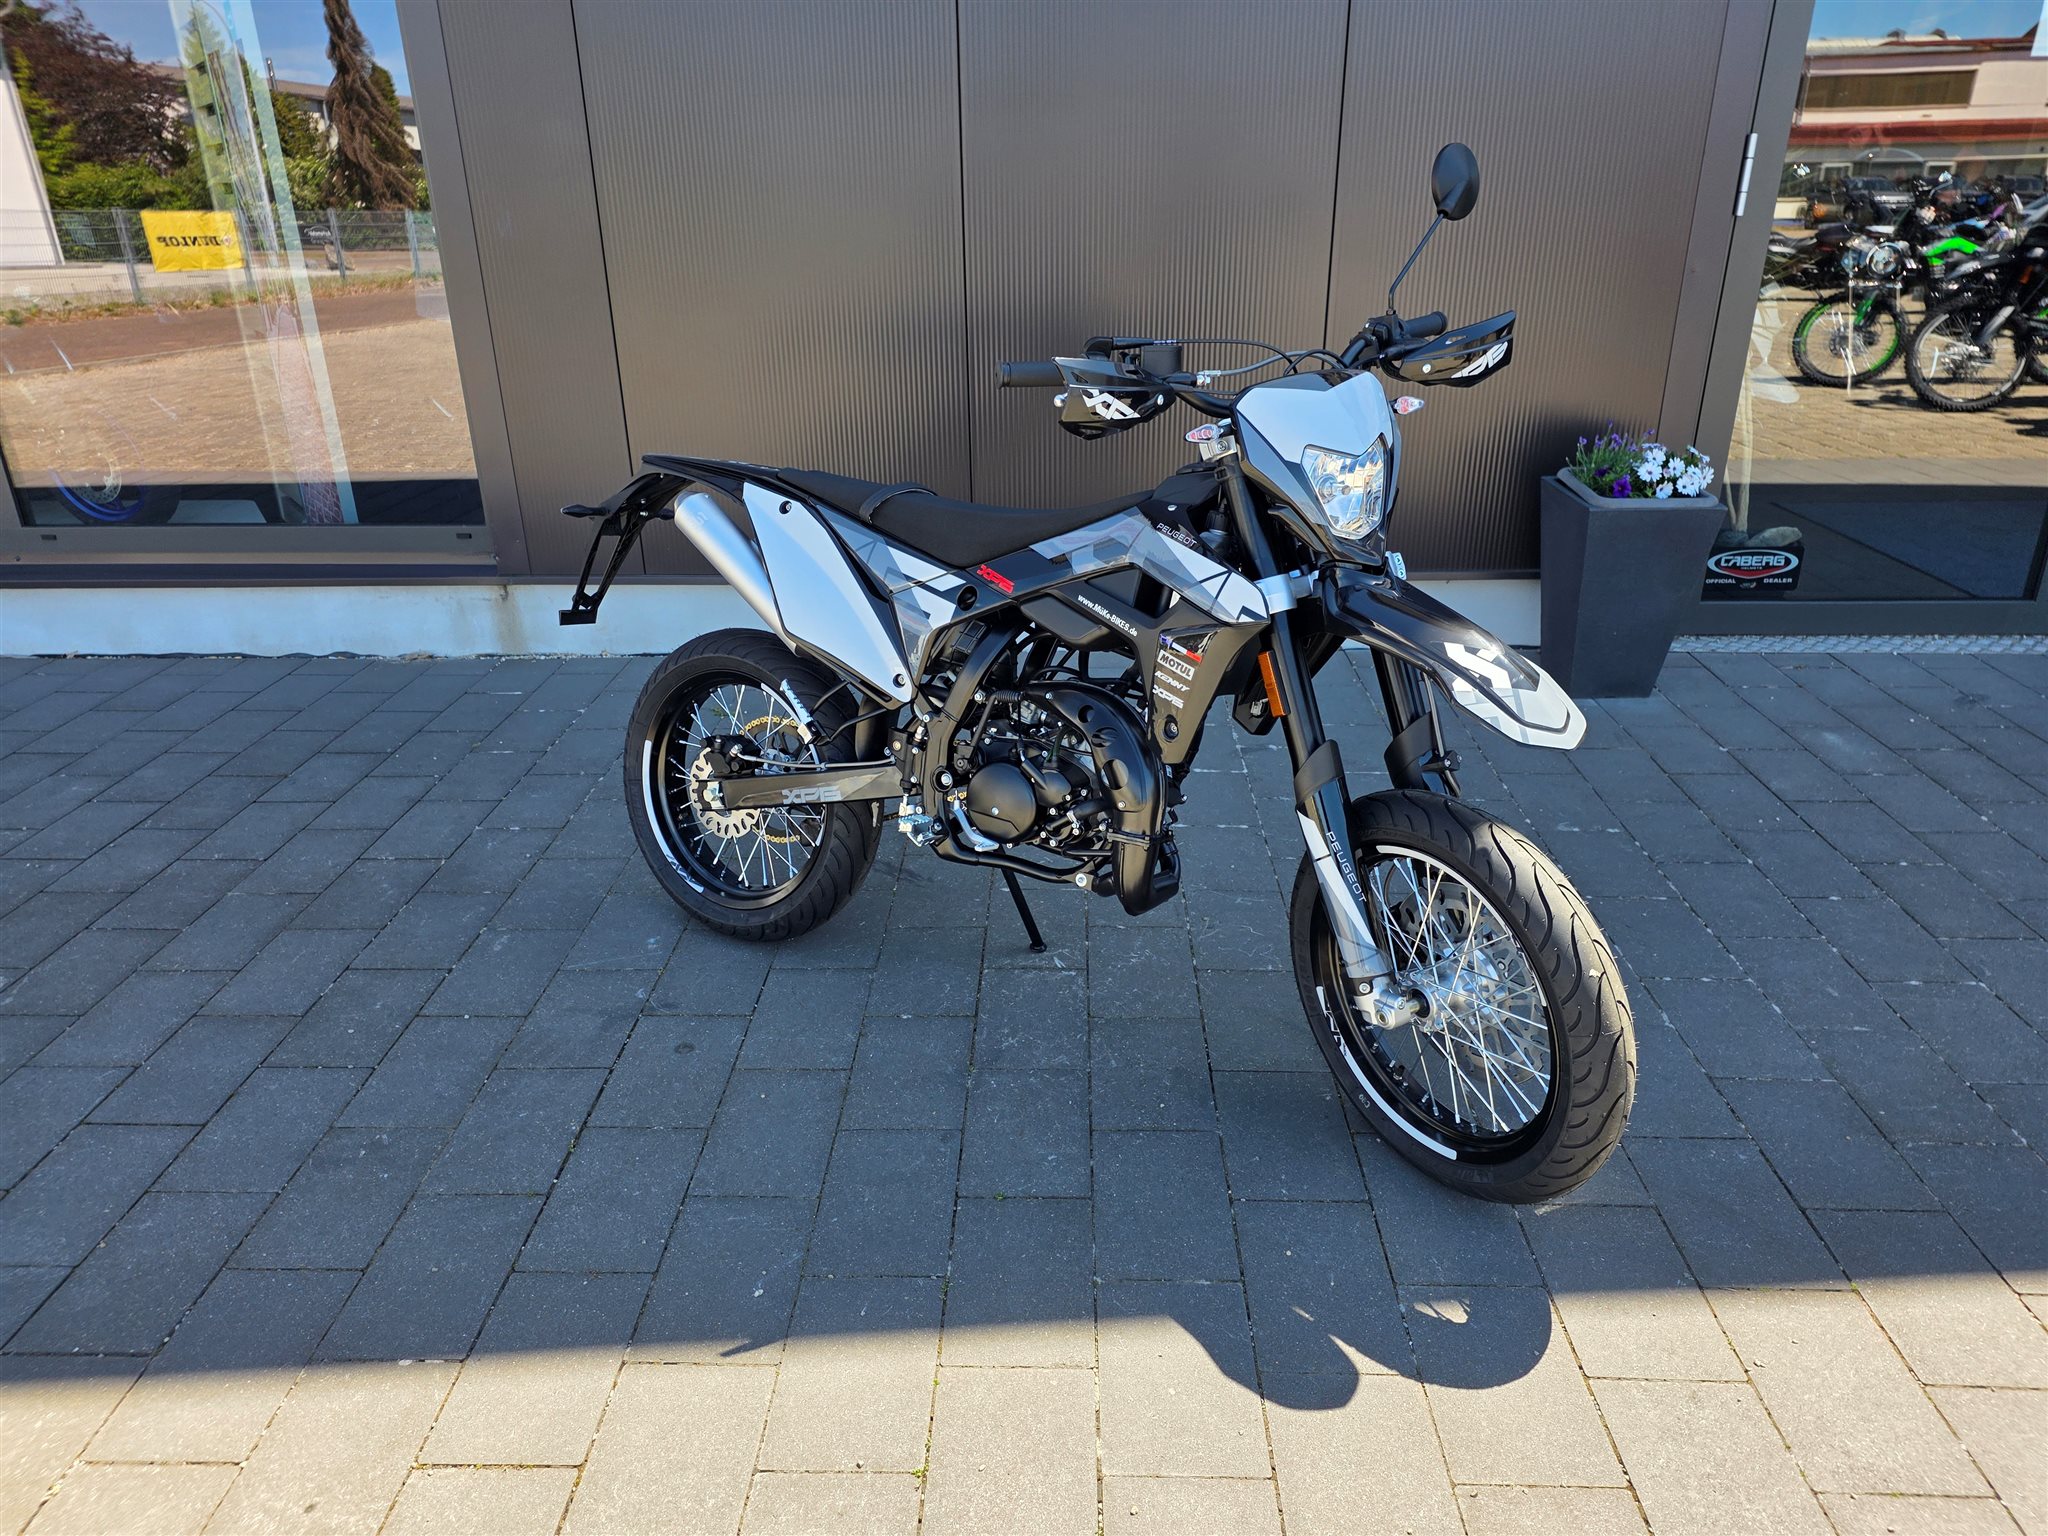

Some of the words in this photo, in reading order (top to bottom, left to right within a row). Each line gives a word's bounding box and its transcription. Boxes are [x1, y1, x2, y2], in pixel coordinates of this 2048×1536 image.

[1156, 522, 1197, 546] PEUGEOT
[1720, 555, 1785, 566] CABERG
[1159, 653, 1193, 678] MOTUL
[1325, 831, 1367, 902] PEUGEOT
